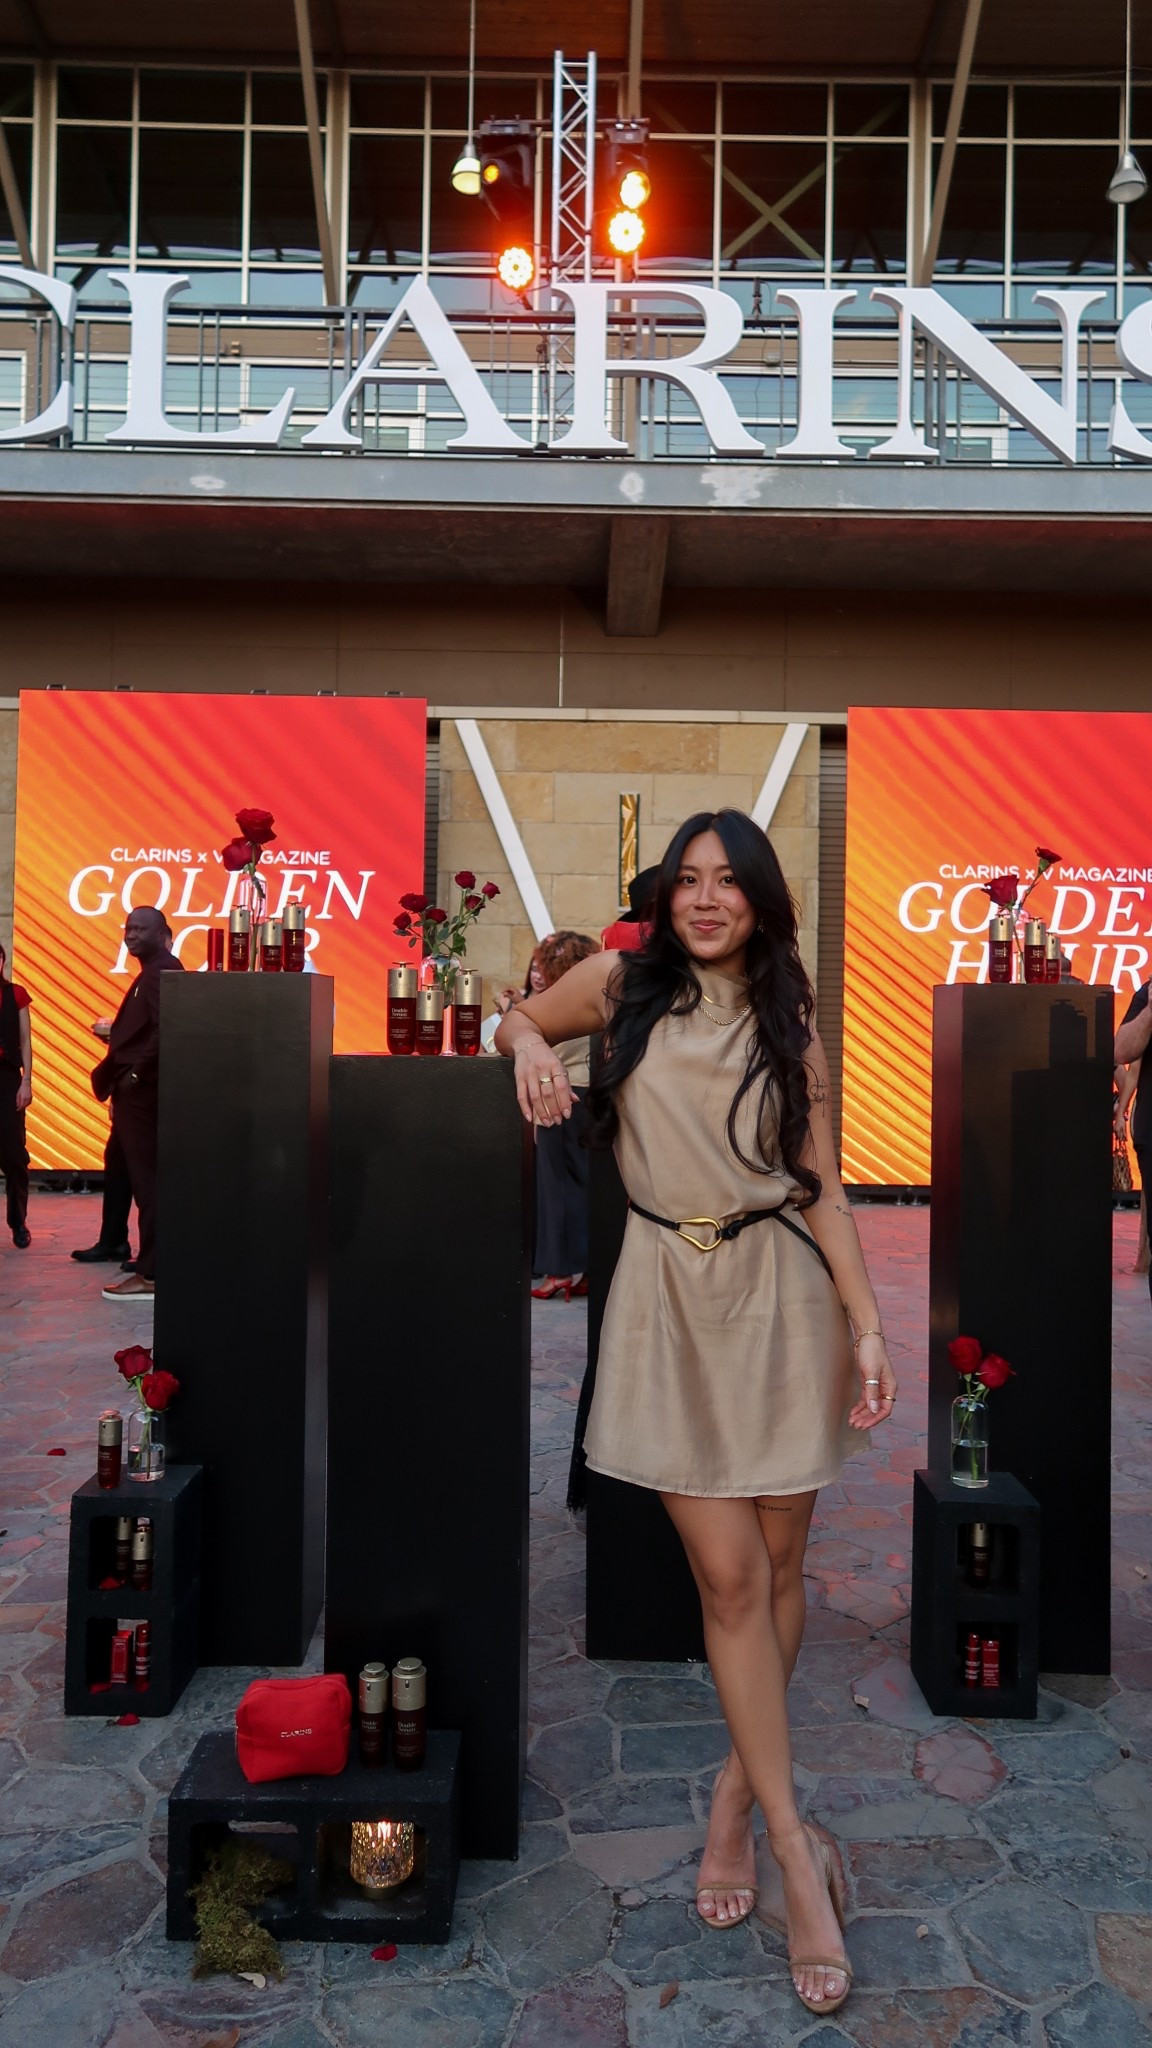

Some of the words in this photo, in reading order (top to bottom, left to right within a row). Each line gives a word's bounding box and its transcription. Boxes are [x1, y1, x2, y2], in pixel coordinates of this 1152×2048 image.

[111, 847, 192, 863] CLARINS
[256, 850, 331, 866] GAZINE
[939, 863, 1020, 879] CLARINS
[898, 881, 1152, 937] GODE
[945, 940, 1149, 993] HUR
